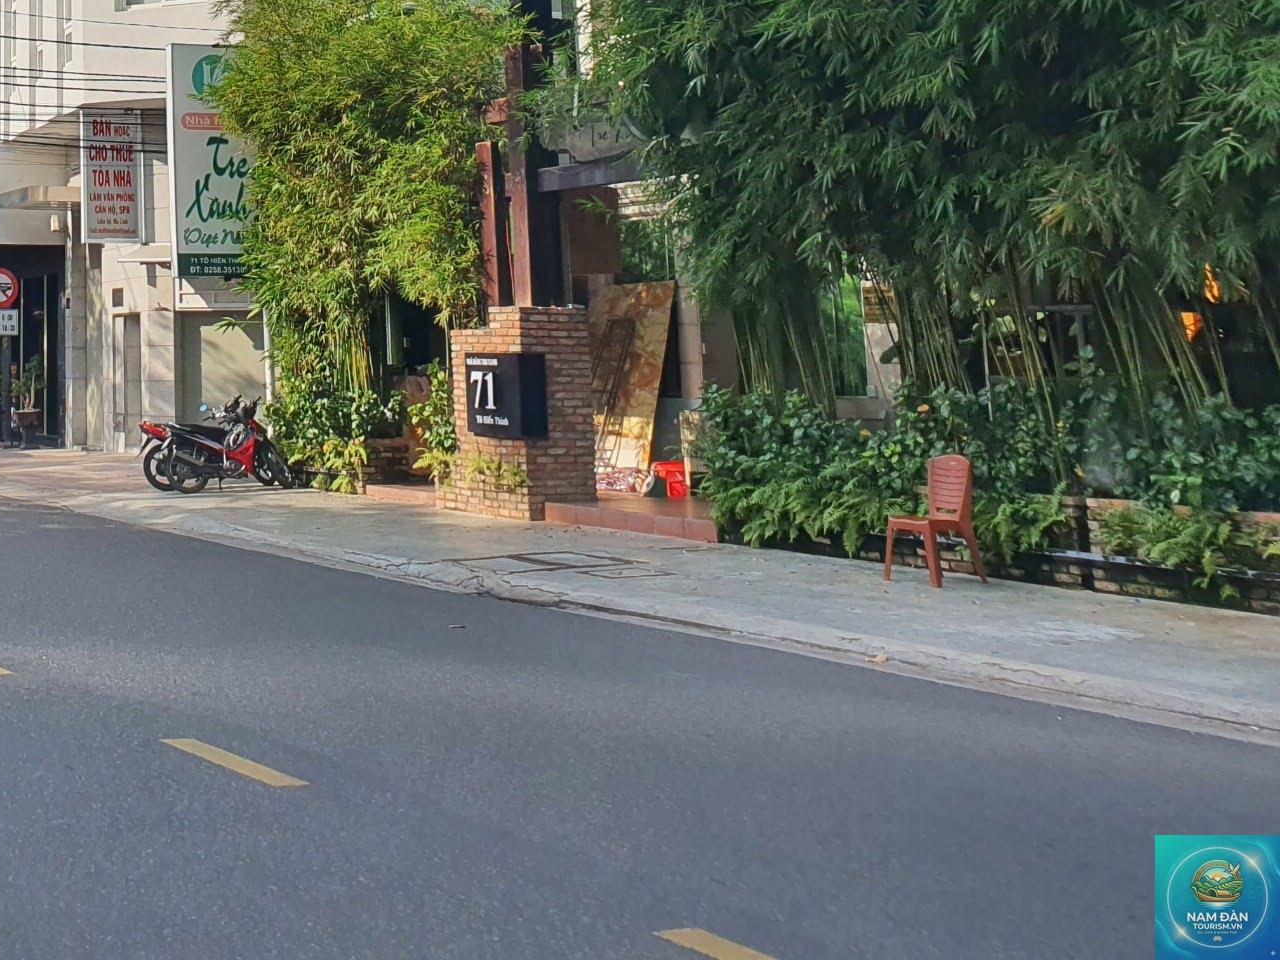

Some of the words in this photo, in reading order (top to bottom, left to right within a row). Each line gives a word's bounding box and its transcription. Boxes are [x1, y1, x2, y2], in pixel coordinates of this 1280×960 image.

[185, 114, 210, 126] Nhà
[88, 143, 108, 162] CHO
[206, 134, 250, 179] Tre
[113, 164, 132, 188] NHÀ
[186, 172, 251, 224] Xanh
[470, 370, 497, 410] 71
